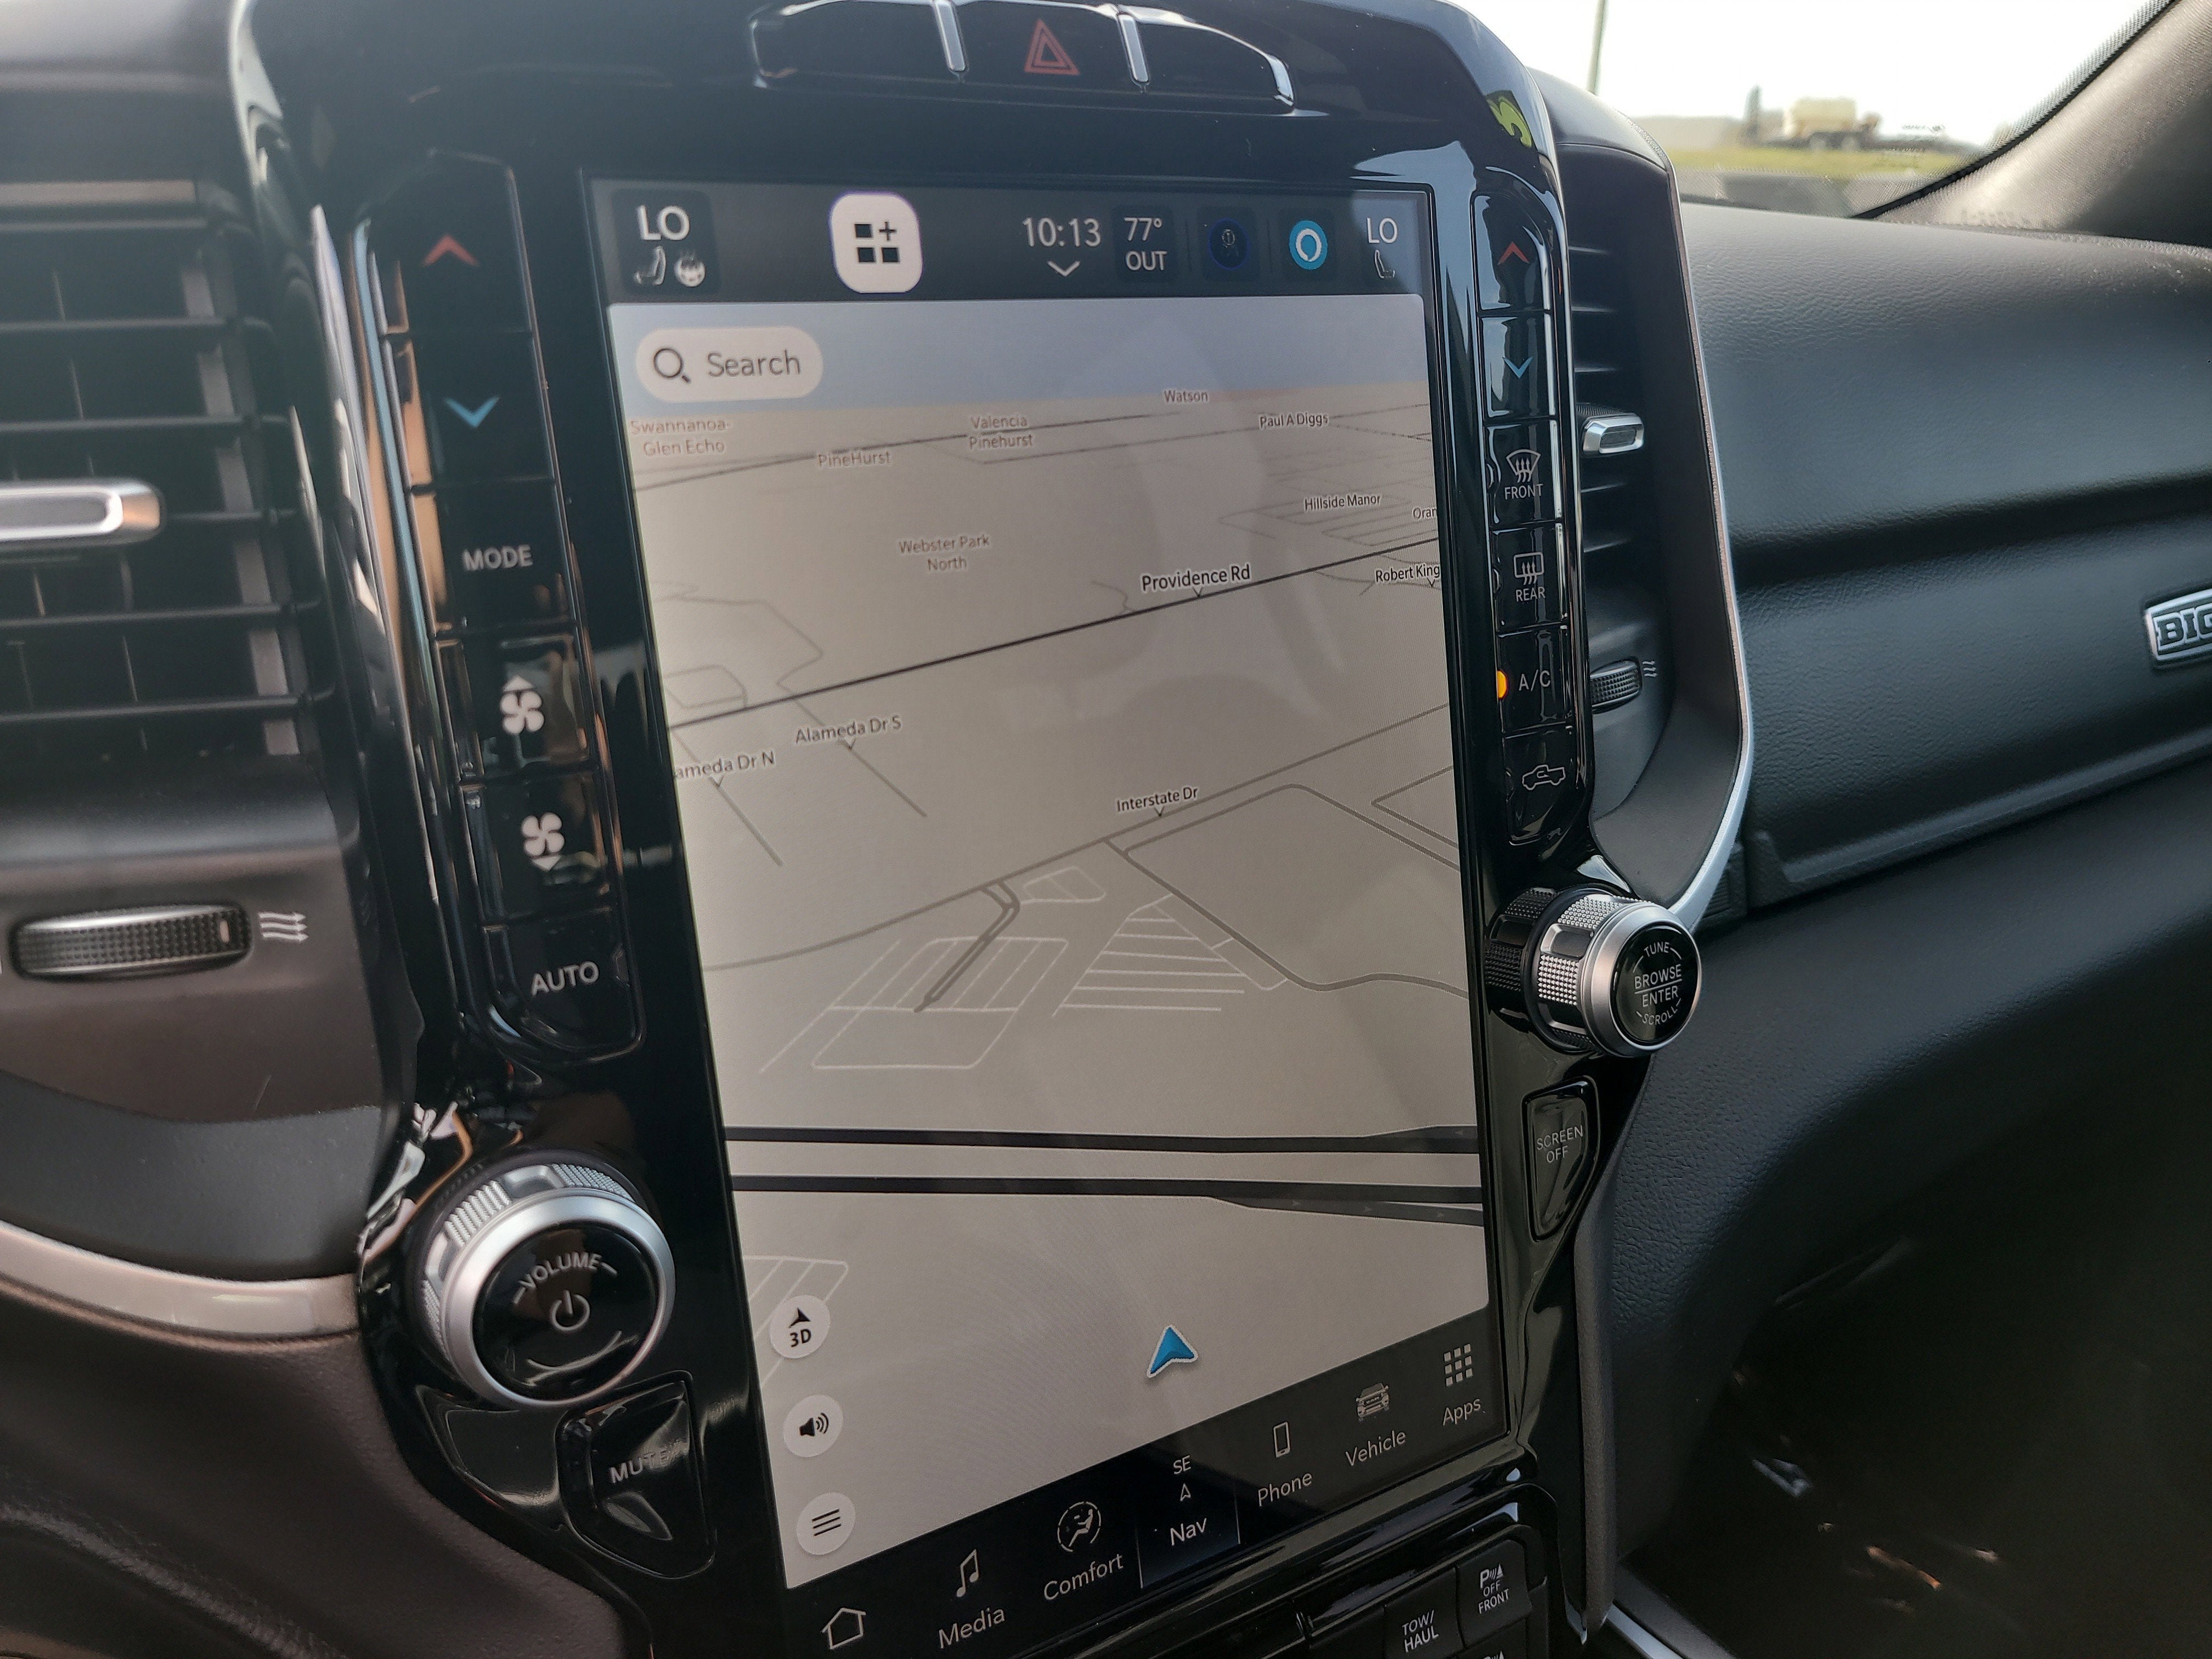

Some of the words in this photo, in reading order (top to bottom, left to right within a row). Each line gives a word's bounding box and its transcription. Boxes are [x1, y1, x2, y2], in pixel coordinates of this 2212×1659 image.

[636, 205, 691, 240] LO
[1022, 217, 1102, 247] 10:13
[1124, 217, 1163, 241] 77°
[1367, 217, 1398, 244] LO
[1125, 251, 1168, 271] OUT
[707, 349, 801, 377] Search
[1164, 390, 1208, 403] Watson
[970, 415, 1028, 429] Valencia
[1260, 414, 1284, 428] Paul
[1286, 414, 1294, 426] A
[1297, 412, 1328, 427] Diggs
[643, 441, 681, 457] Glen
[685, 438, 725, 454] Echo
[969, 433, 1033, 449] Pinehurst
[818, 451, 891, 467] PineHurst
[1304, 495, 1345, 511] Hillside
[1348, 493, 1381, 507] Manor
[1504, 484, 1543, 500] FRONT
[899, 538, 956, 554] Webster
[960, 534, 990, 548] Park
[462, 544, 534, 573] MODE
[927, 557, 967, 572] North
[1142, 571, 1227, 591] Providence
[1231, 564, 1251, 582] Rd
[1375, 567, 1414, 583] Robert
[1416, 563, 1440, 578] King
[1515, 586, 1545, 602] REAR
[1518, 669, 1551, 691] A/C
[795, 722, 866, 744] Alameda
[870, 717, 889, 734] Dr
[891, 716, 902, 730] S
[738, 754, 757, 770] Dr
[762, 751, 775, 766] N
[1116, 791, 1180, 812] Interstate
[1183, 787, 1198, 800] Dr
[1643, 941, 1671, 957] TUNE
[530, 960, 600, 996] AUTO
[1633, 963, 1683, 989] BROWSE
[1642, 985, 1679, 1008] ENTER
[1641, 1006, 1679, 1026] SCROLL
[1537, 1125, 1583, 1151] SCREEN
[1546, 1146, 1569, 1164] OFF
[520, 1251, 603, 1291] VOLUME
[789, 1328, 812, 1348] 3D
[1442, 1397, 1482, 1426] Apps
[1345, 1430, 1407, 1467] Vehicle
[1173, 1455, 1192, 1474] SE
[1258, 1471, 1313, 1506] Phone
[1170, 1517, 1207, 1546] Nav
[1043, 1553, 1124, 1601] Comfort
[1483, 1580, 1502, 1598] OFF
[1477, 1589, 1510, 1615] FRONT
[938, 1606, 1005, 1649] Media
[1402, 1610, 1436, 1634] TOW/
[1403, 1624, 1440, 1653] HAUL
